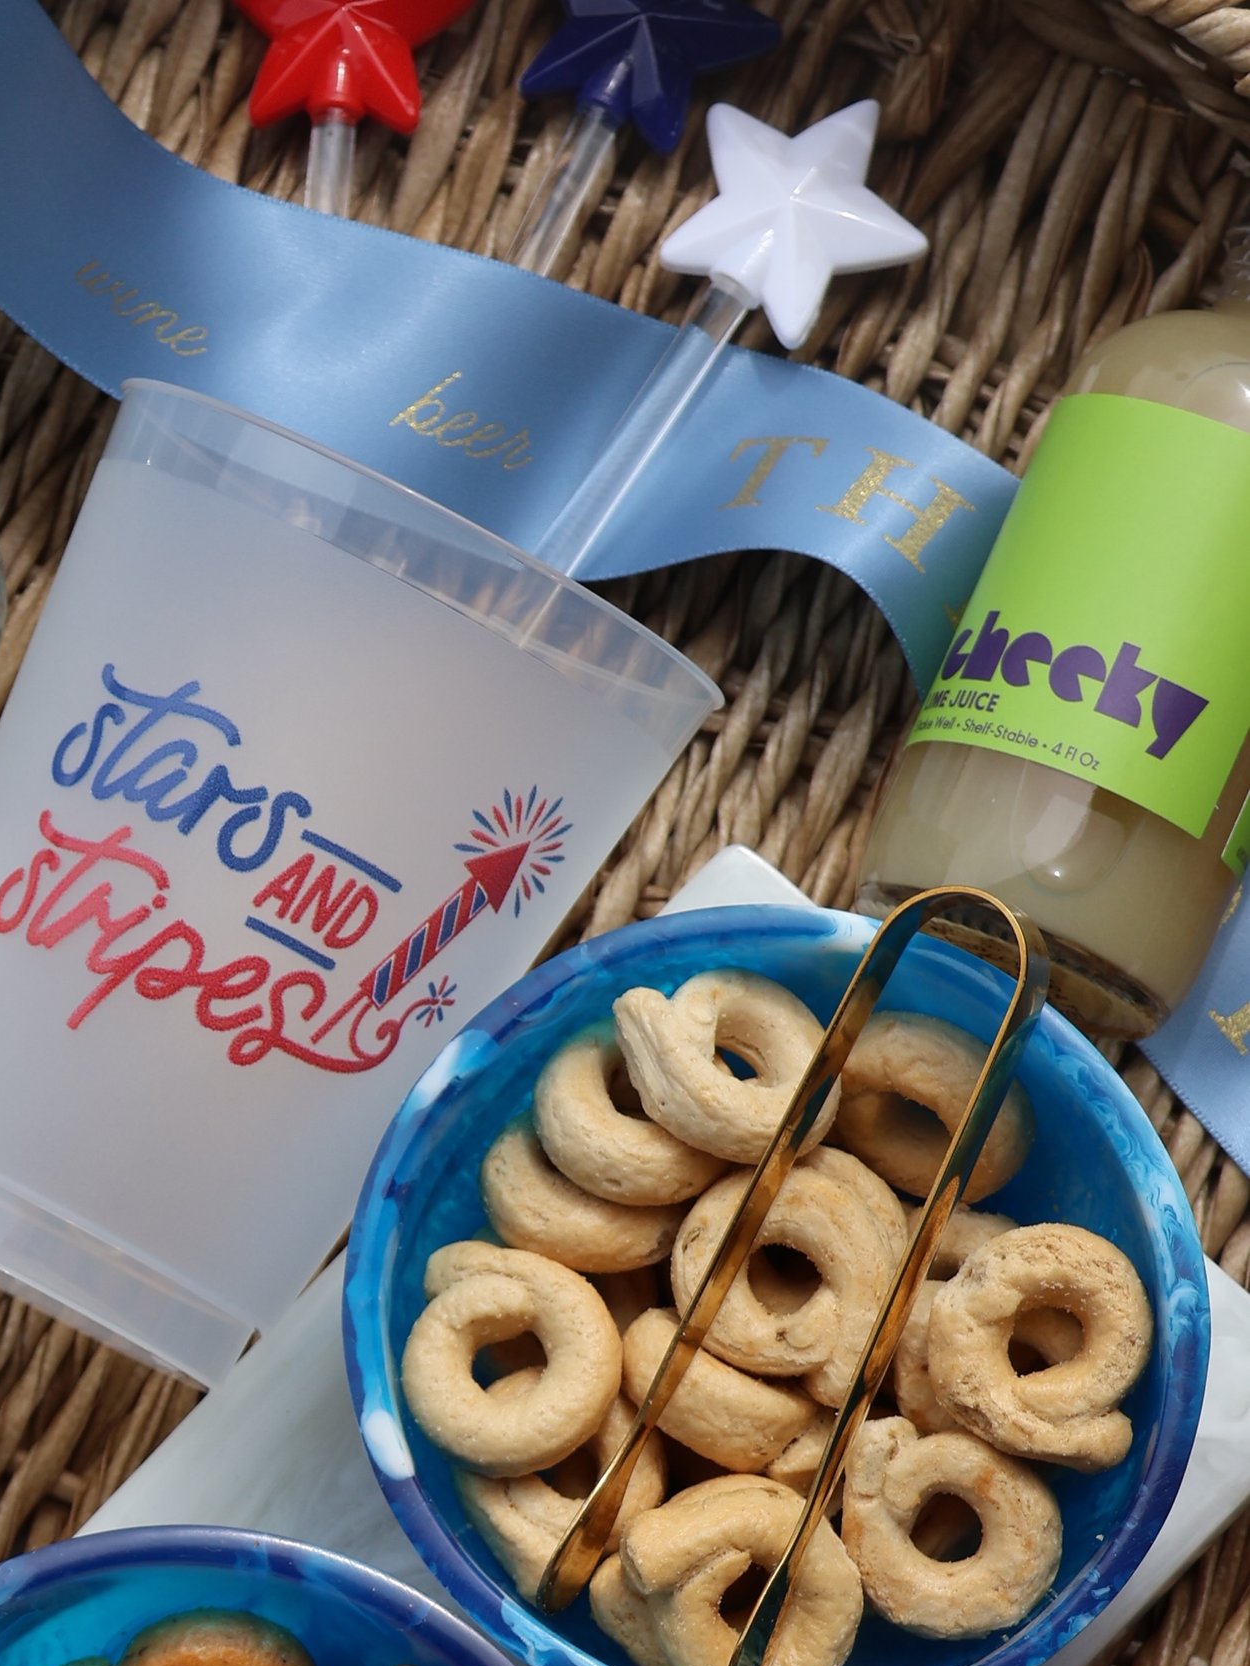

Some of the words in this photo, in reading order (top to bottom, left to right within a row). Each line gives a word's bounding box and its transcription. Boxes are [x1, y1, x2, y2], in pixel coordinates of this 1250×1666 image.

[389, 370, 534, 471] beer
[718, 433, 976, 628] TH
[941, 610, 1210, 761] cheeky
[949, 689, 1000, 712] JUICE
[51, 662, 312, 873] stars
[962, 718, 1039, 748] Shelf-Stable
[1050, 741, 1062, 757] 4
[1080, 752, 1100, 771] Oz
[252, 851, 380, 950] AND
